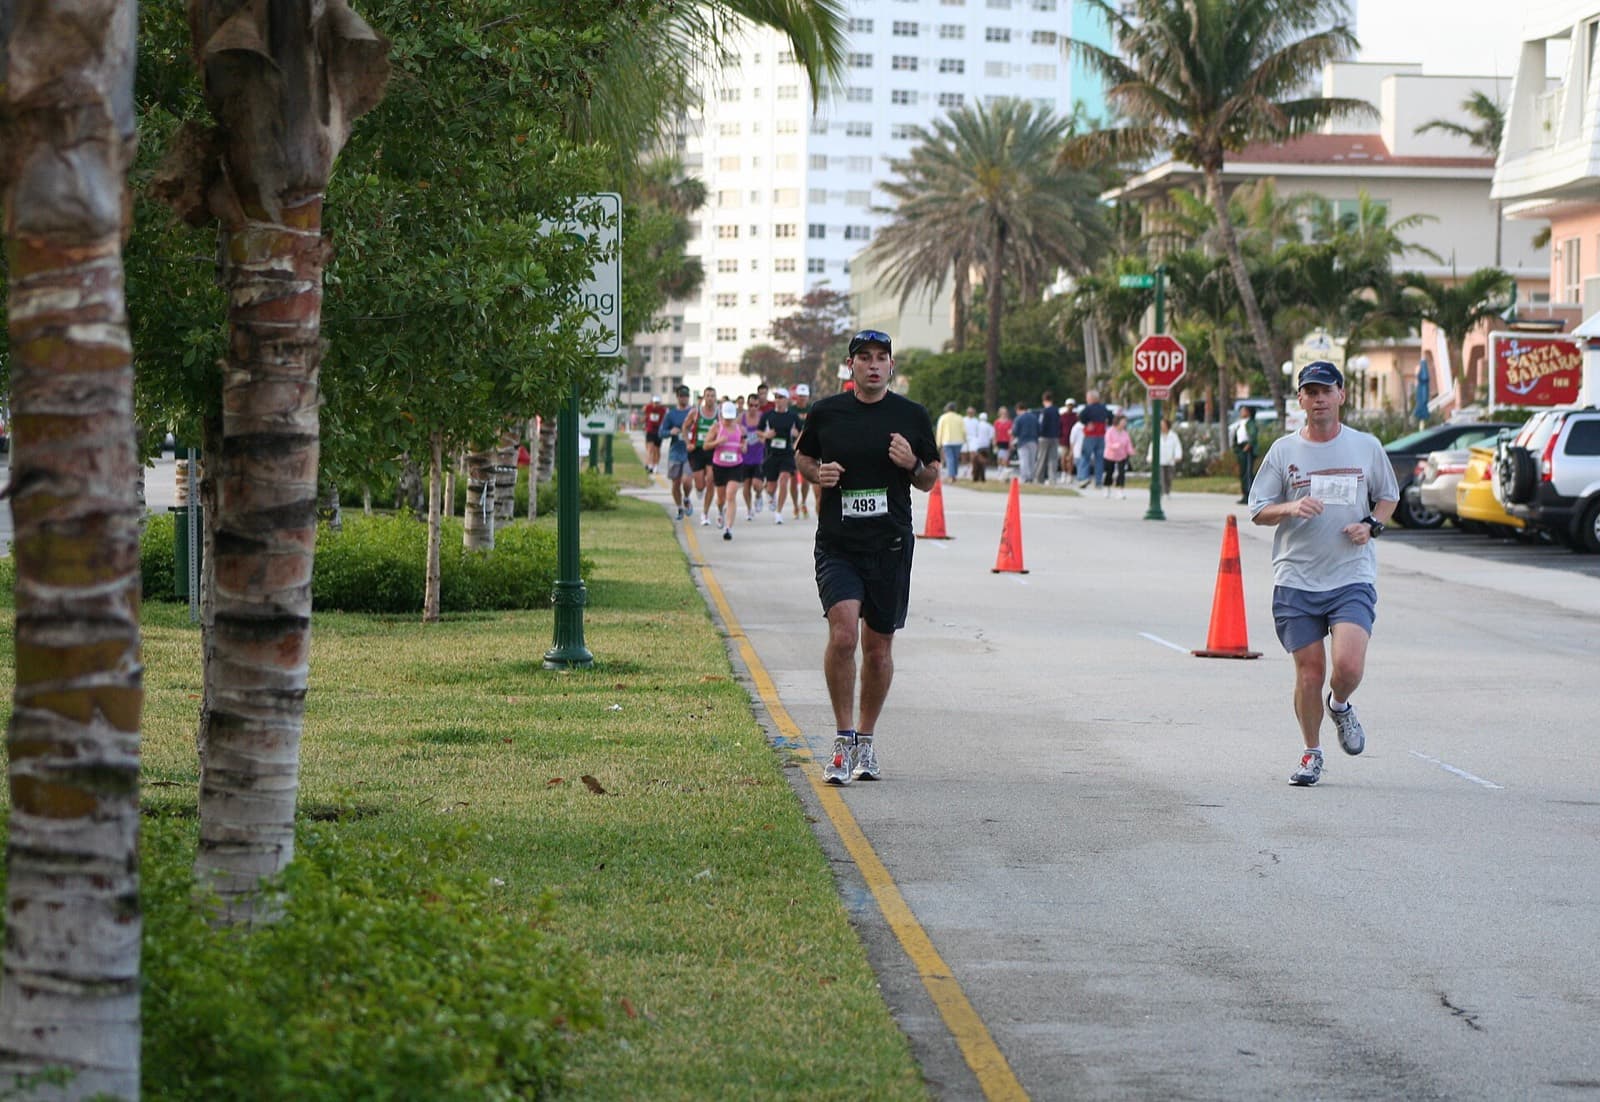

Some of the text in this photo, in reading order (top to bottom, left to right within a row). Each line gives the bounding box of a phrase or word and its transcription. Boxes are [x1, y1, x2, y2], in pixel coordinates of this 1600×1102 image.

[1136, 350, 1183, 372] STOP
[1508, 345, 1562, 368] SANTA
[1507, 353, 1582, 384] BARBARA
[852, 498, 876, 513] 493
